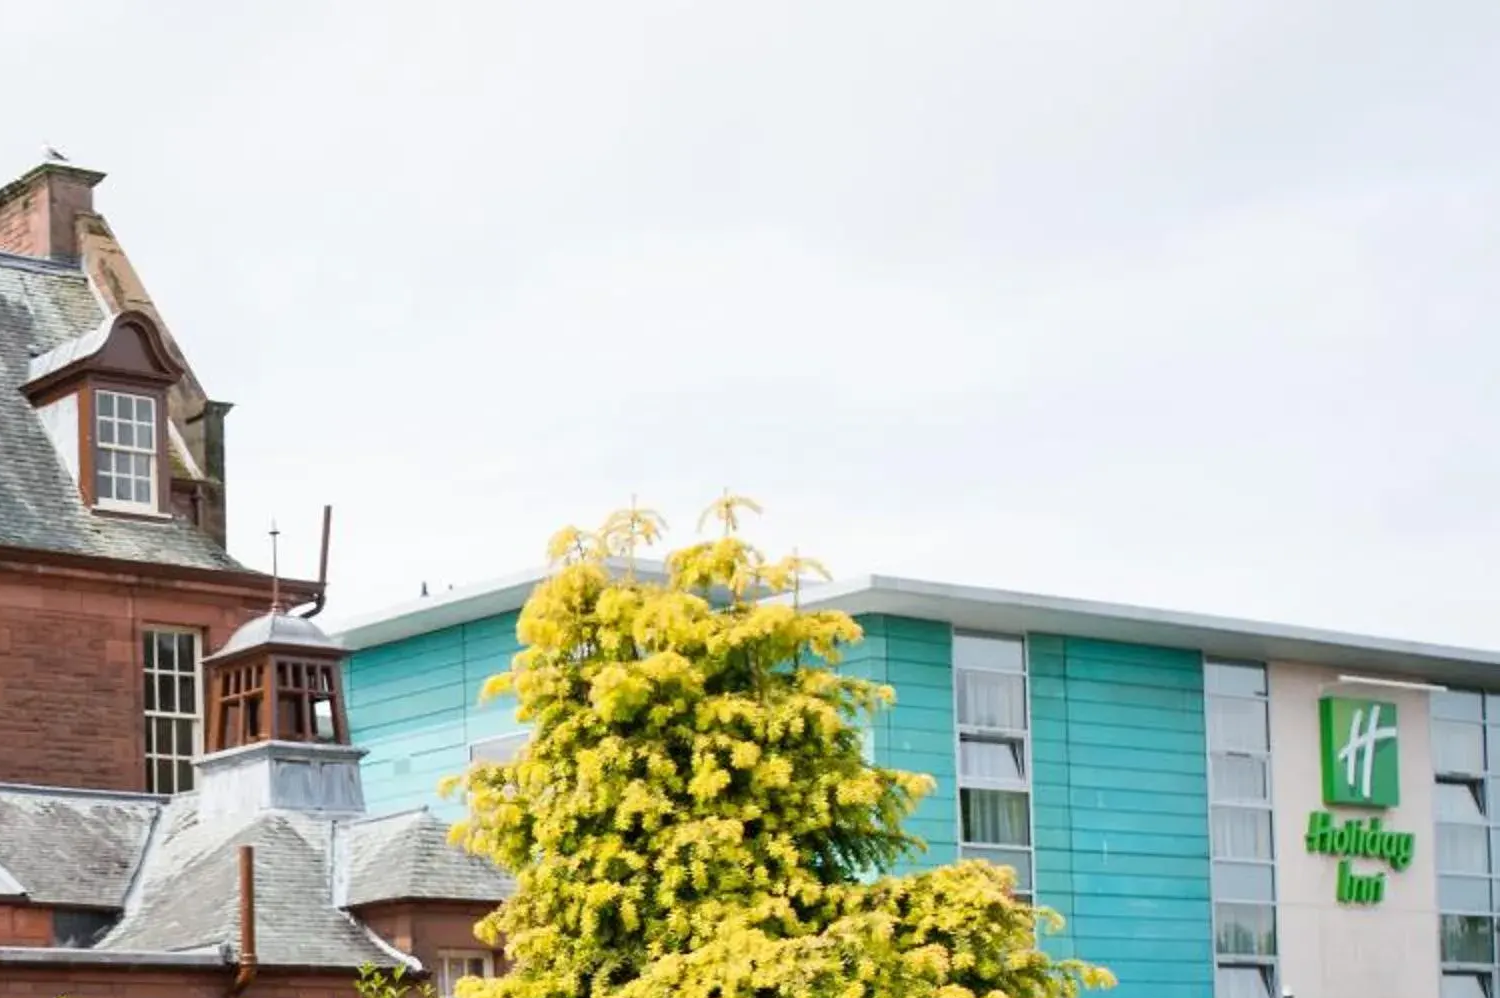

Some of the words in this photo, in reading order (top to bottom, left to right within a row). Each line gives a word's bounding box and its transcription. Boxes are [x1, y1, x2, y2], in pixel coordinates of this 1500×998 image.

[1337, 705, 1397, 798] H
[1305, 811, 1415, 872] Holiday
[1336, 860, 1385, 904] Inn
